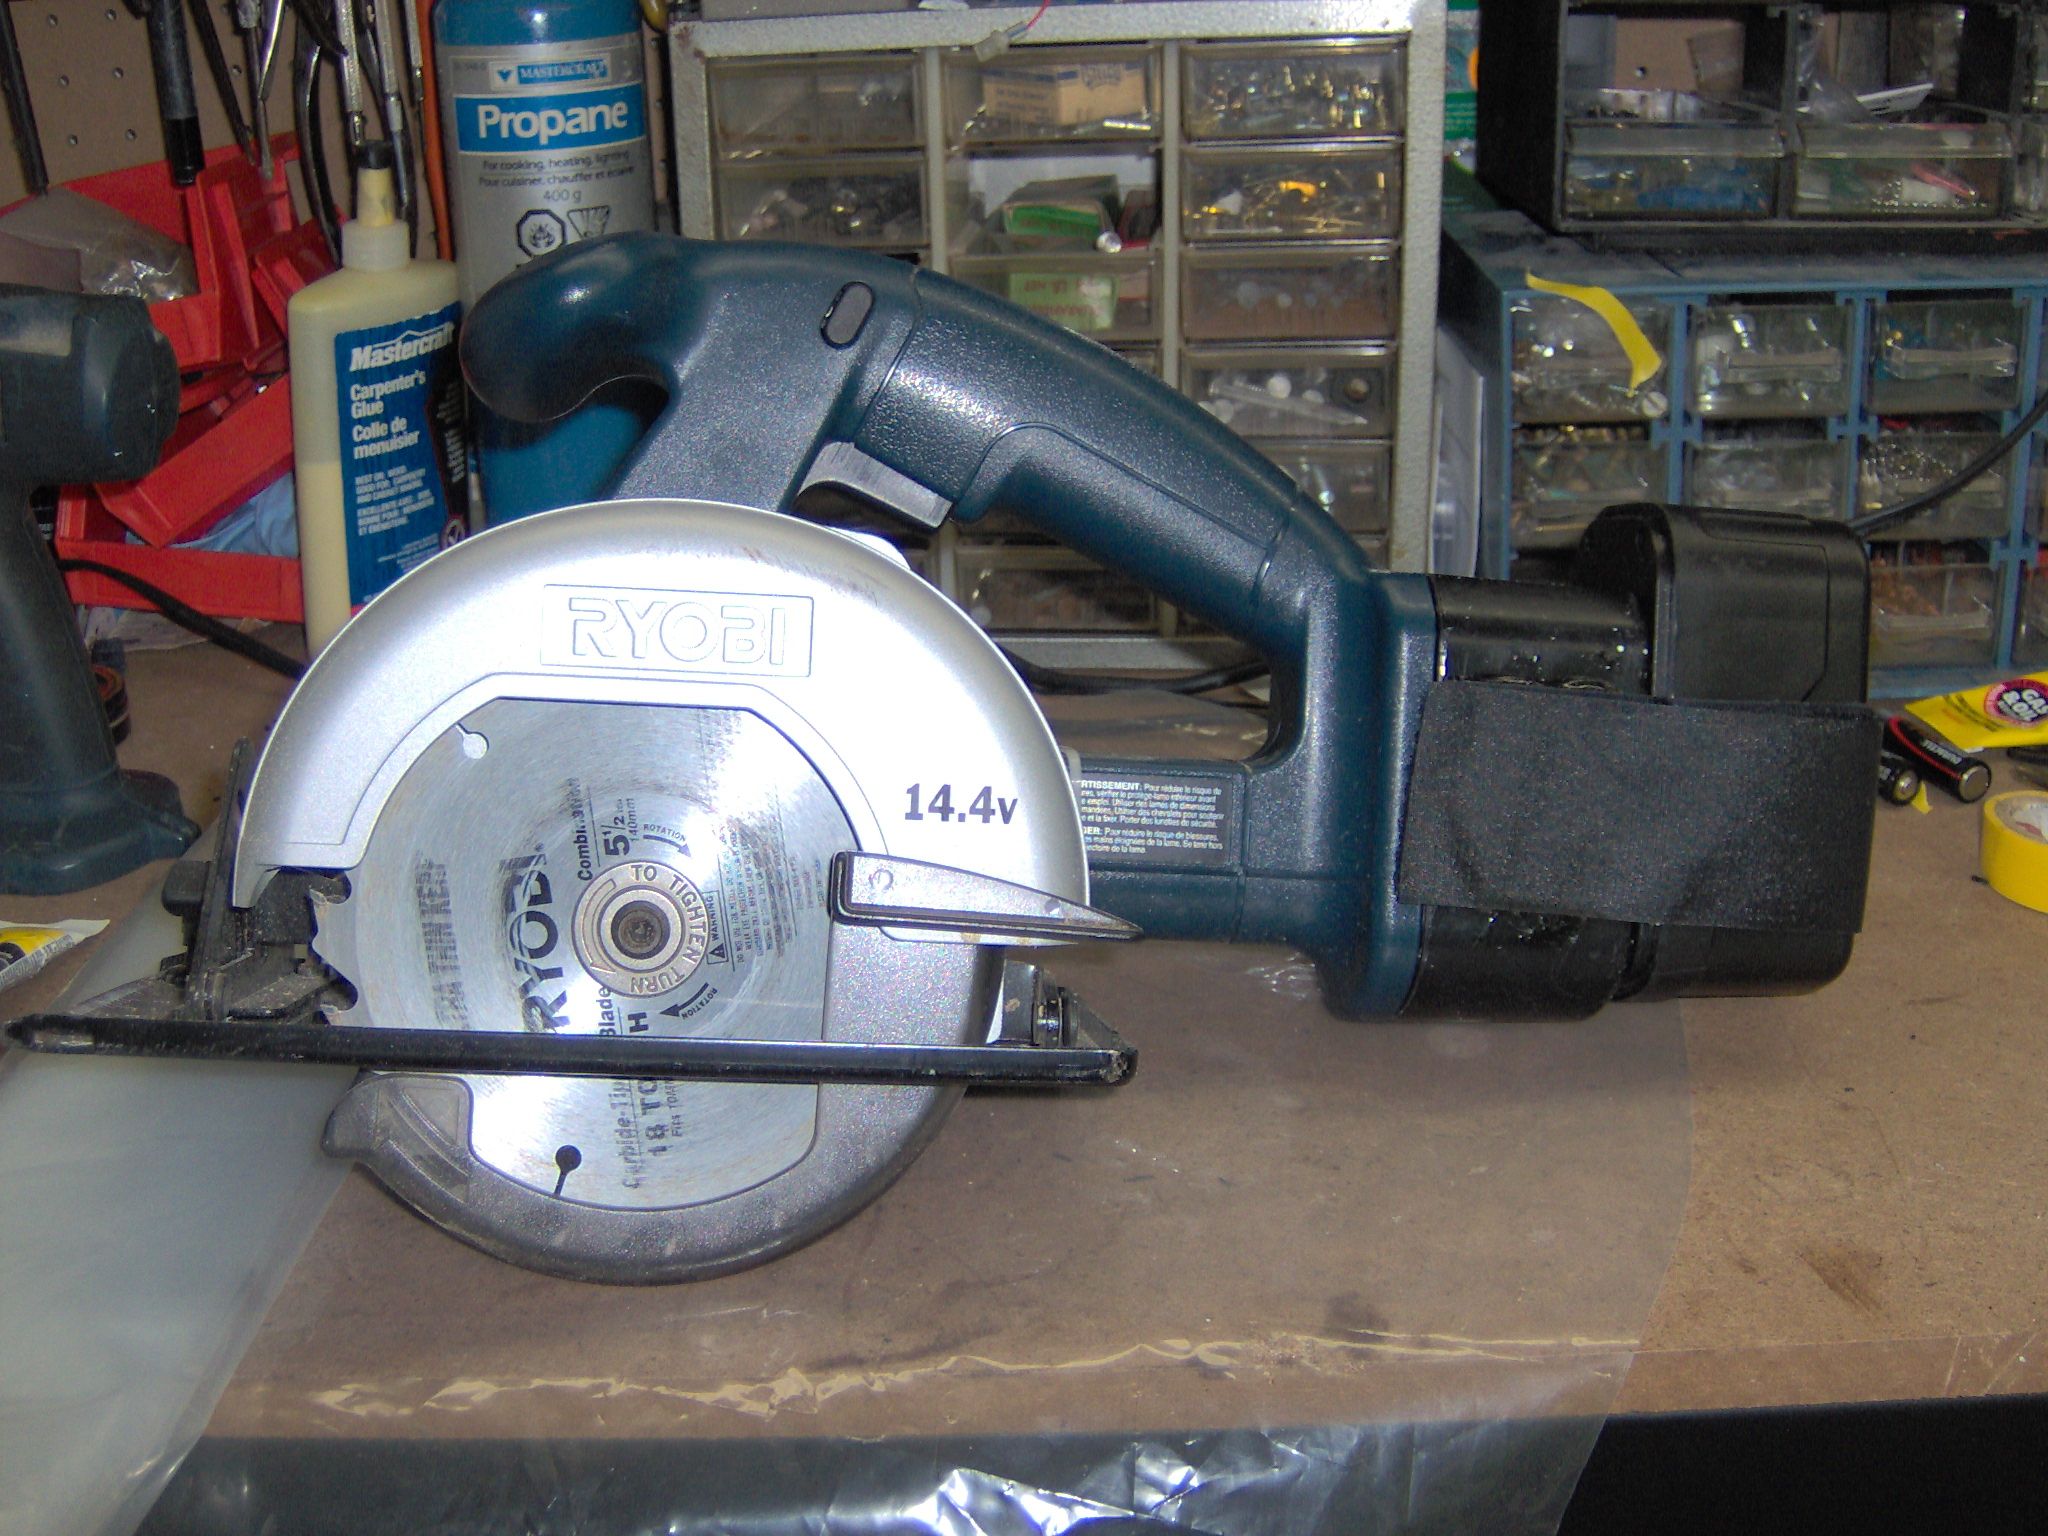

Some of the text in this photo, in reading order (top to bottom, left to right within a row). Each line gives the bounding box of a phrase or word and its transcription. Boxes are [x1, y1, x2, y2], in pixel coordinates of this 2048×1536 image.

[477, 101, 629, 145] Propane
[543, 189, 582, 203] 400 g
[350, 322, 455, 371] Mastercraft
[351, 370, 426, 401] Carpenter's
[351, 400, 384, 419] Glue
[352, 416, 407, 442] Colle de
[354, 430, 420, 459] menuisier
[568, 596, 786, 666] RYOBI
[642, 823, 687, 842] ROTATION
[630, 864, 707, 994] TO TIGHTEN TURN
[705, 895, 719, 942] WARNING
[596, 985, 617, 1036] Blade
[681, 987, 718, 1020] ROTATION
